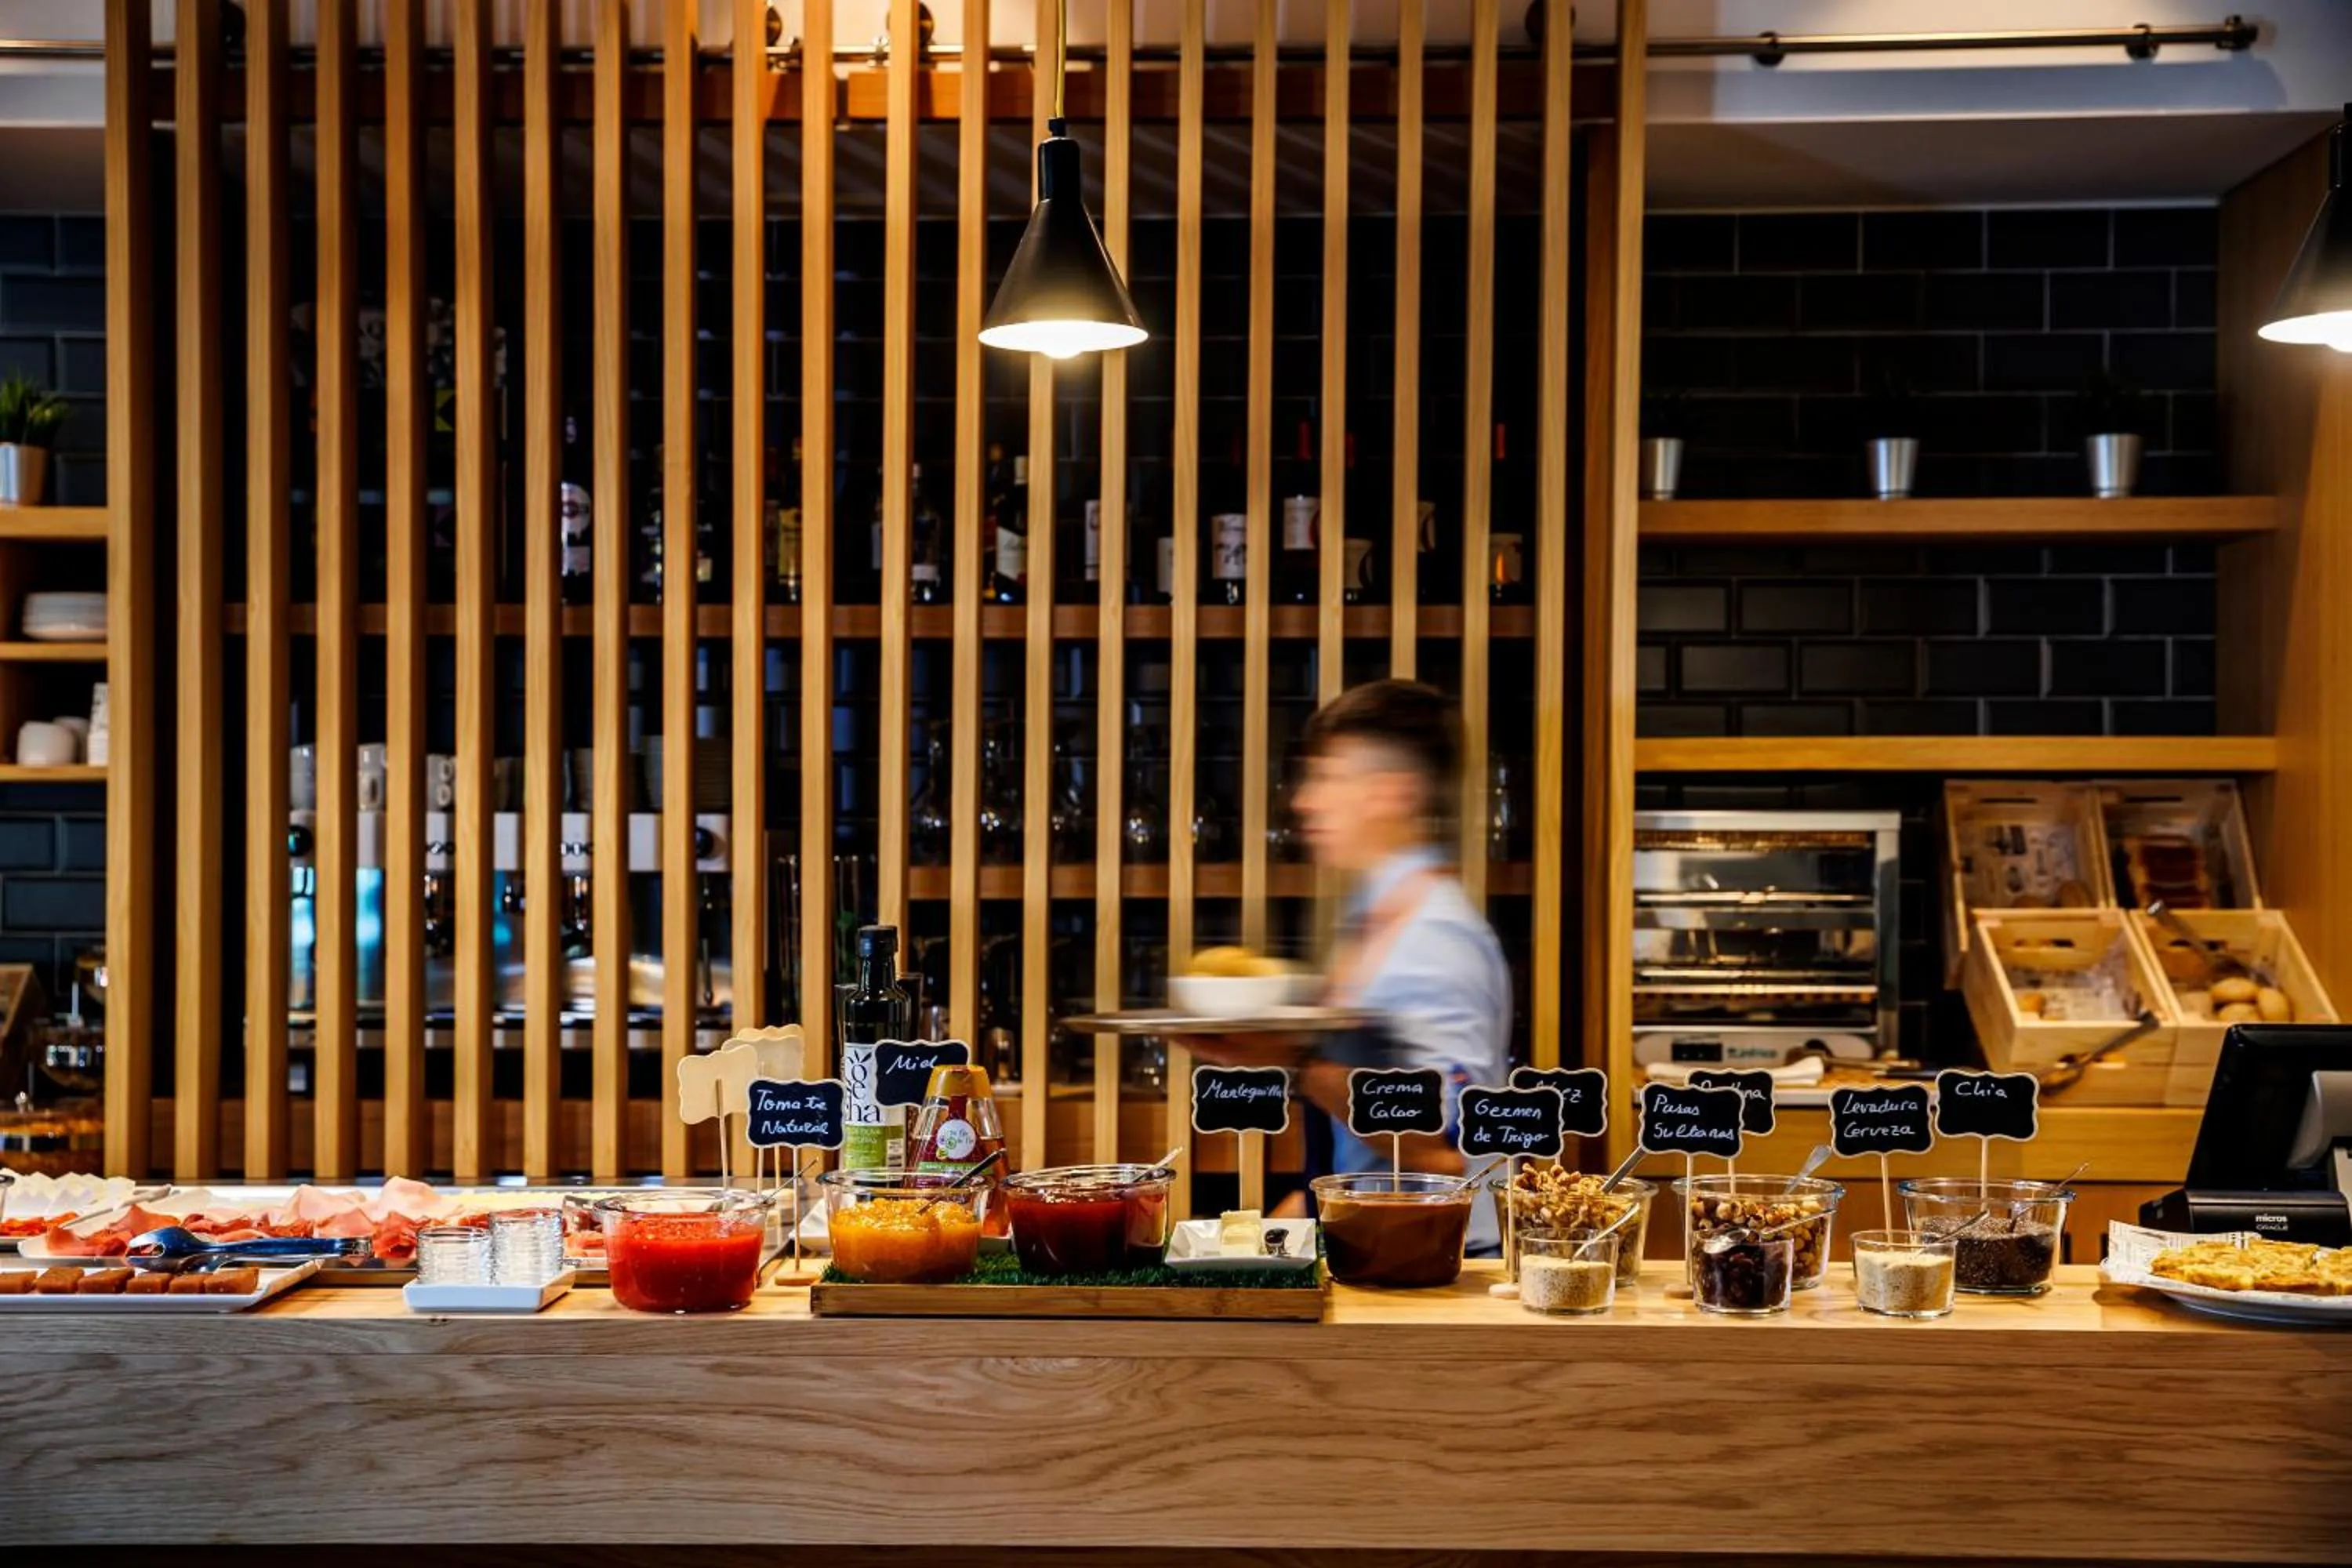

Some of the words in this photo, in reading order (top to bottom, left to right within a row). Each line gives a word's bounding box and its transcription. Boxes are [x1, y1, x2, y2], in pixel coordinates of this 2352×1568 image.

[1362, 1078, 1424, 1094] Crema
[1955, 1081, 2008, 1098] Chia
[1370, 1101, 1423, 1119] Cacao
[1474, 1098, 1542, 1120] Germen
[1653, 1094, 1700, 1115] Pasas
[1842, 1093, 1918, 1114] Levadura
[761, 1118, 829, 1134] Natural
[1653, 1123, 1735, 1140] Sultanas
[1843, 1121, 1916, 1138] Cerveza
[1473, 1126, 1492, 1142] de
[1497, 1125, 1549, 1149] Trigo
